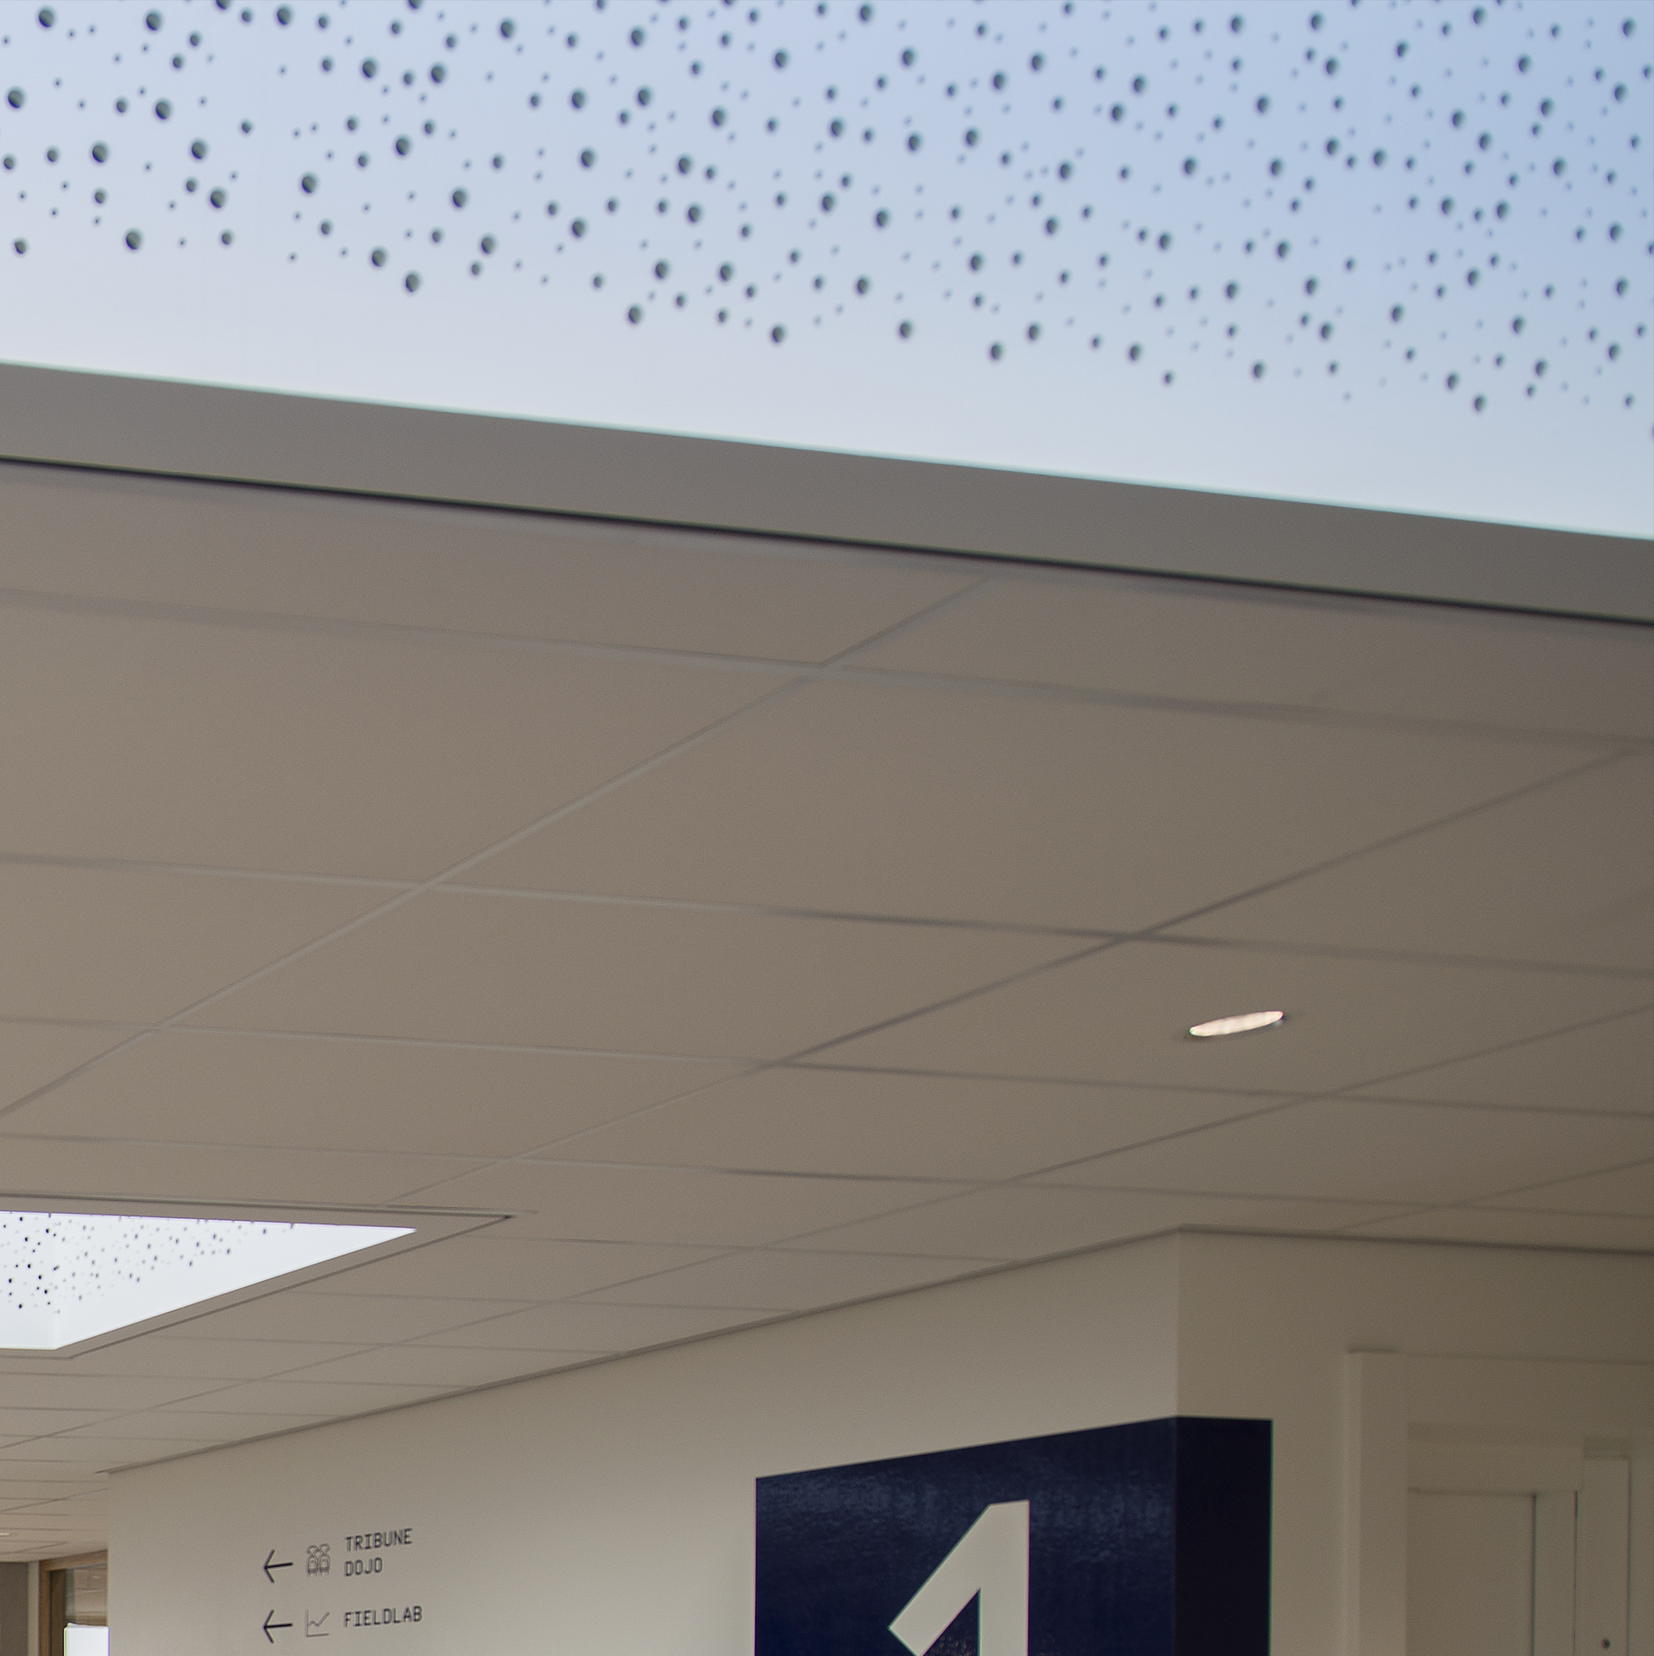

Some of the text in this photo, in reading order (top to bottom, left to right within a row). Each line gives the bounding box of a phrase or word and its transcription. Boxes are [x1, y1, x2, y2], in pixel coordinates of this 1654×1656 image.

[345, 1528, 413, 1551] TRIBUNE
[345, 1557, 383, 1577] DOJO
[344, 1605, 423, 1628] FIELDLAB
